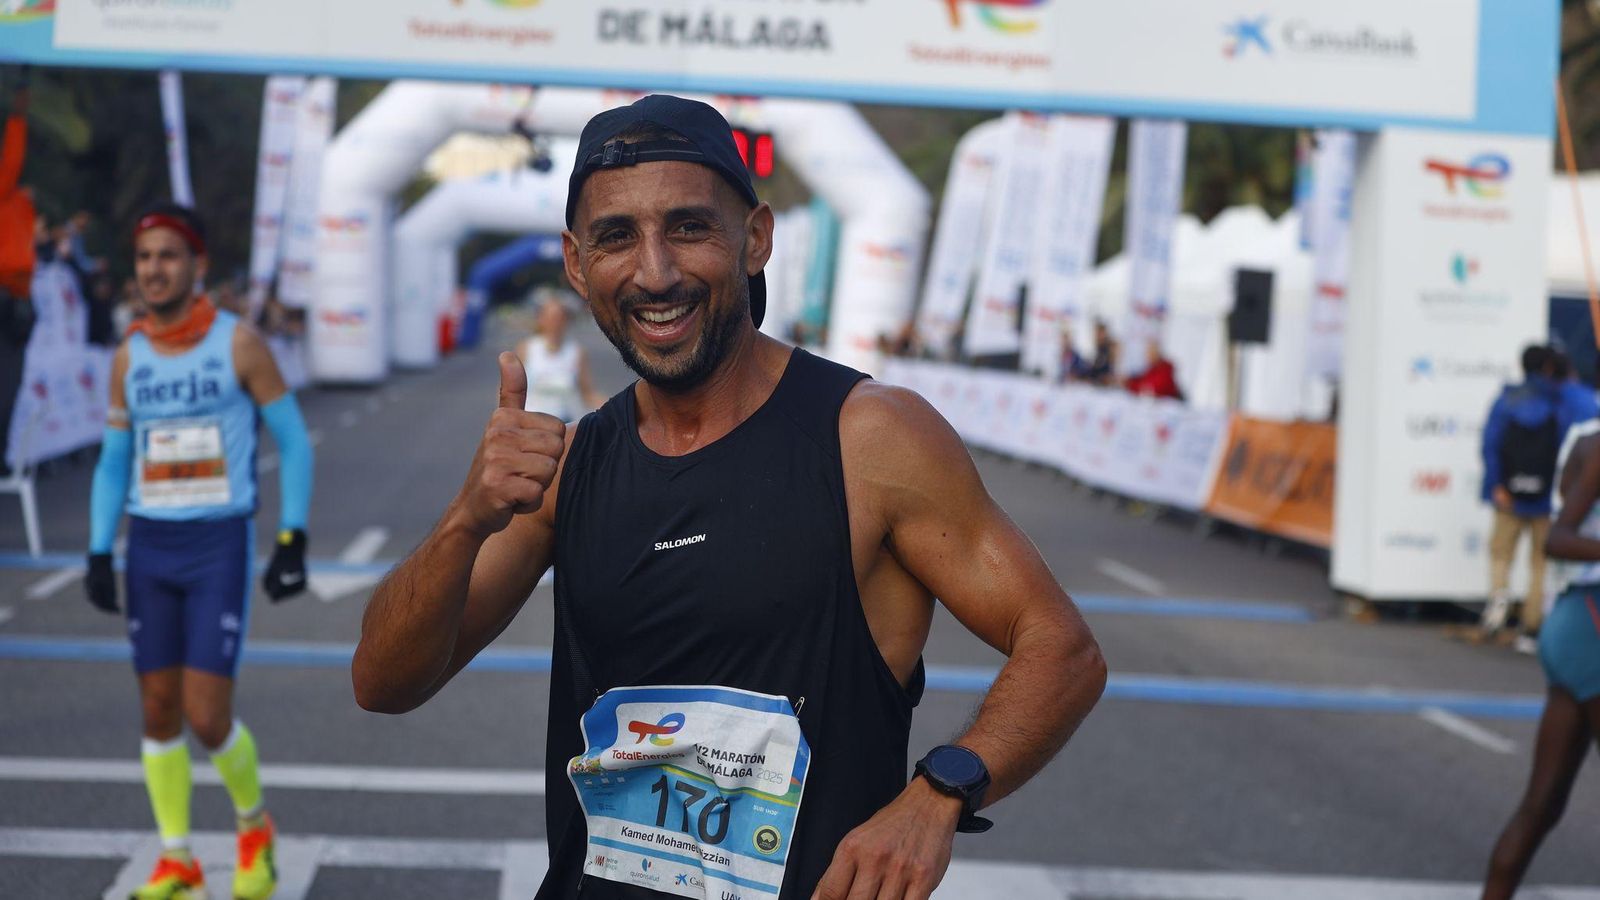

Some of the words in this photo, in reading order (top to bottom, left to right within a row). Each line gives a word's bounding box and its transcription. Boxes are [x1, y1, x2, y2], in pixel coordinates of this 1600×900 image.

[598, 9, 649, 43] DE
[659, 9, 832, 50] MÁLAGA
[654, 533, 706, 551] SALOMON
[711, 748, 766, 765] MARATÓN
[707, 762, 753, 778] MÁLAGA
[756, 767, 784, 785] 2025
[651, 774, 731, 845] 170
[620, 826, 655, 842] Kamed
